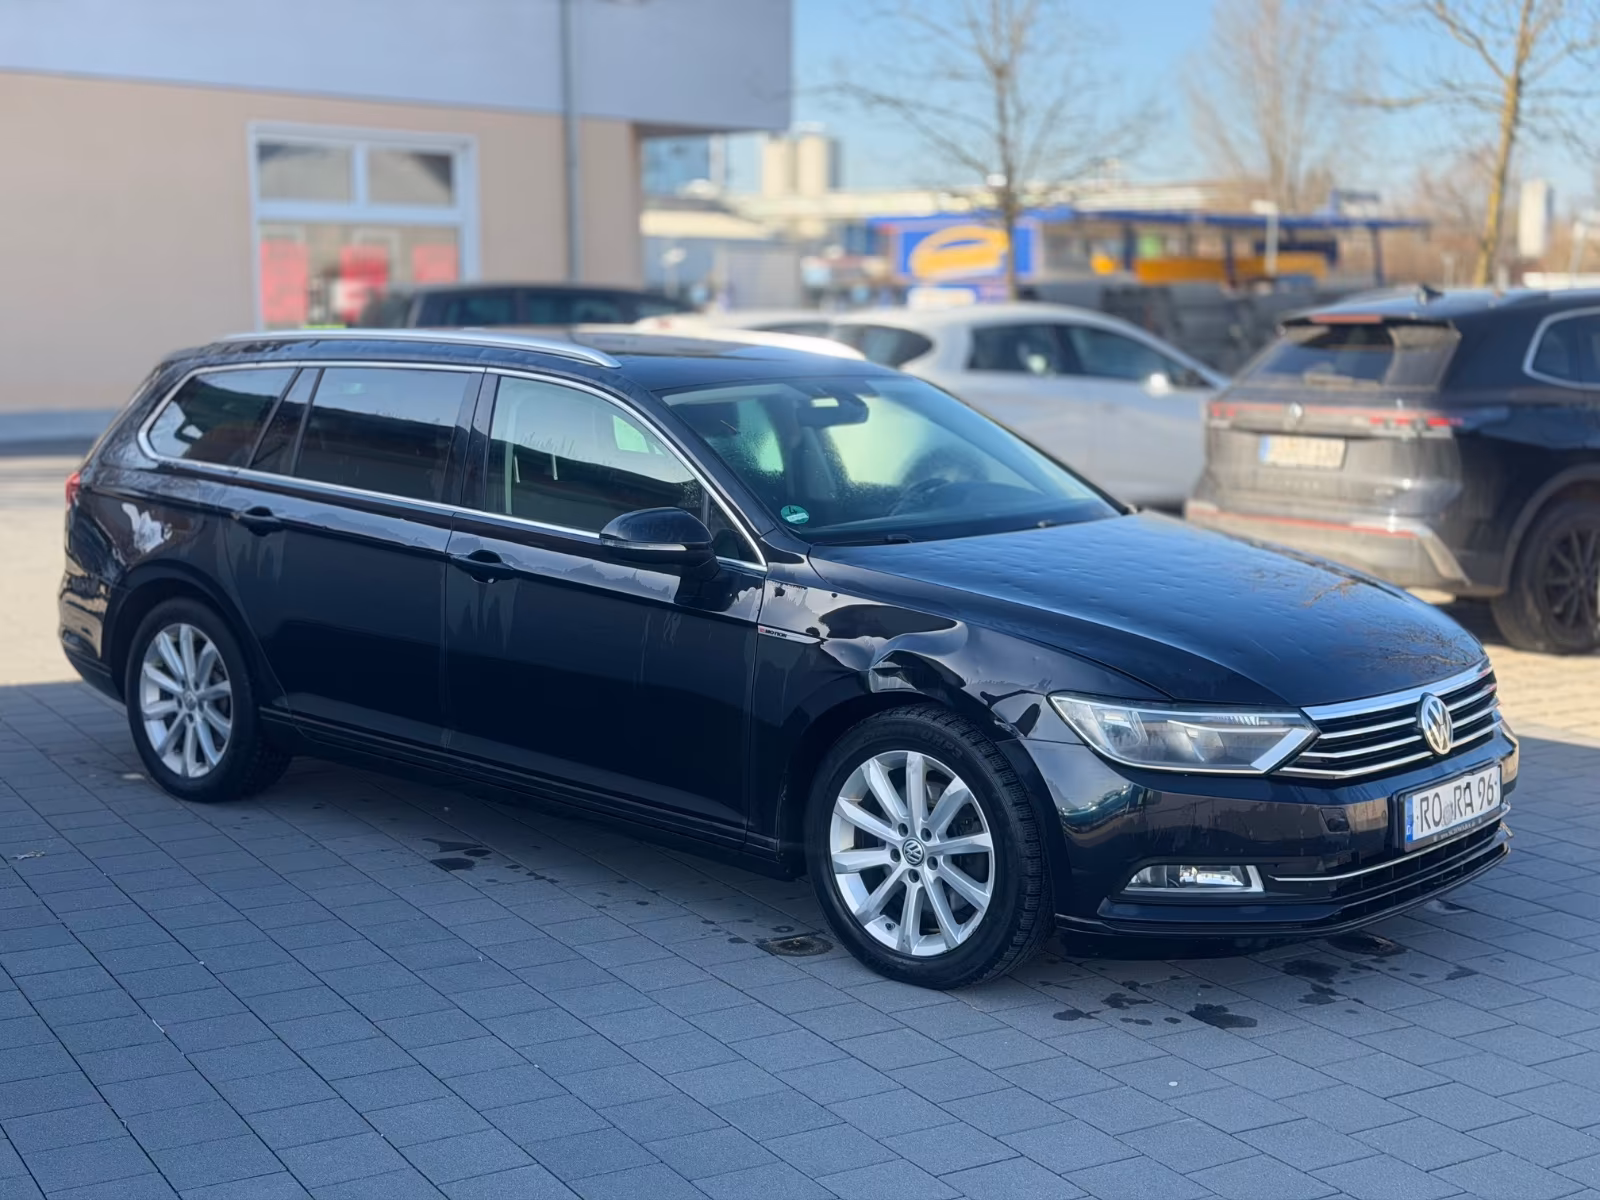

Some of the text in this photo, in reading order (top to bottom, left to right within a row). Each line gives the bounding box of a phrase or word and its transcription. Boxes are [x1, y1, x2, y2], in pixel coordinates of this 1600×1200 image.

[1420, 792, 1443, 832] RO
[1453, 782, 1474, 820] RA
[1478, 773, 1494, 810] 96
